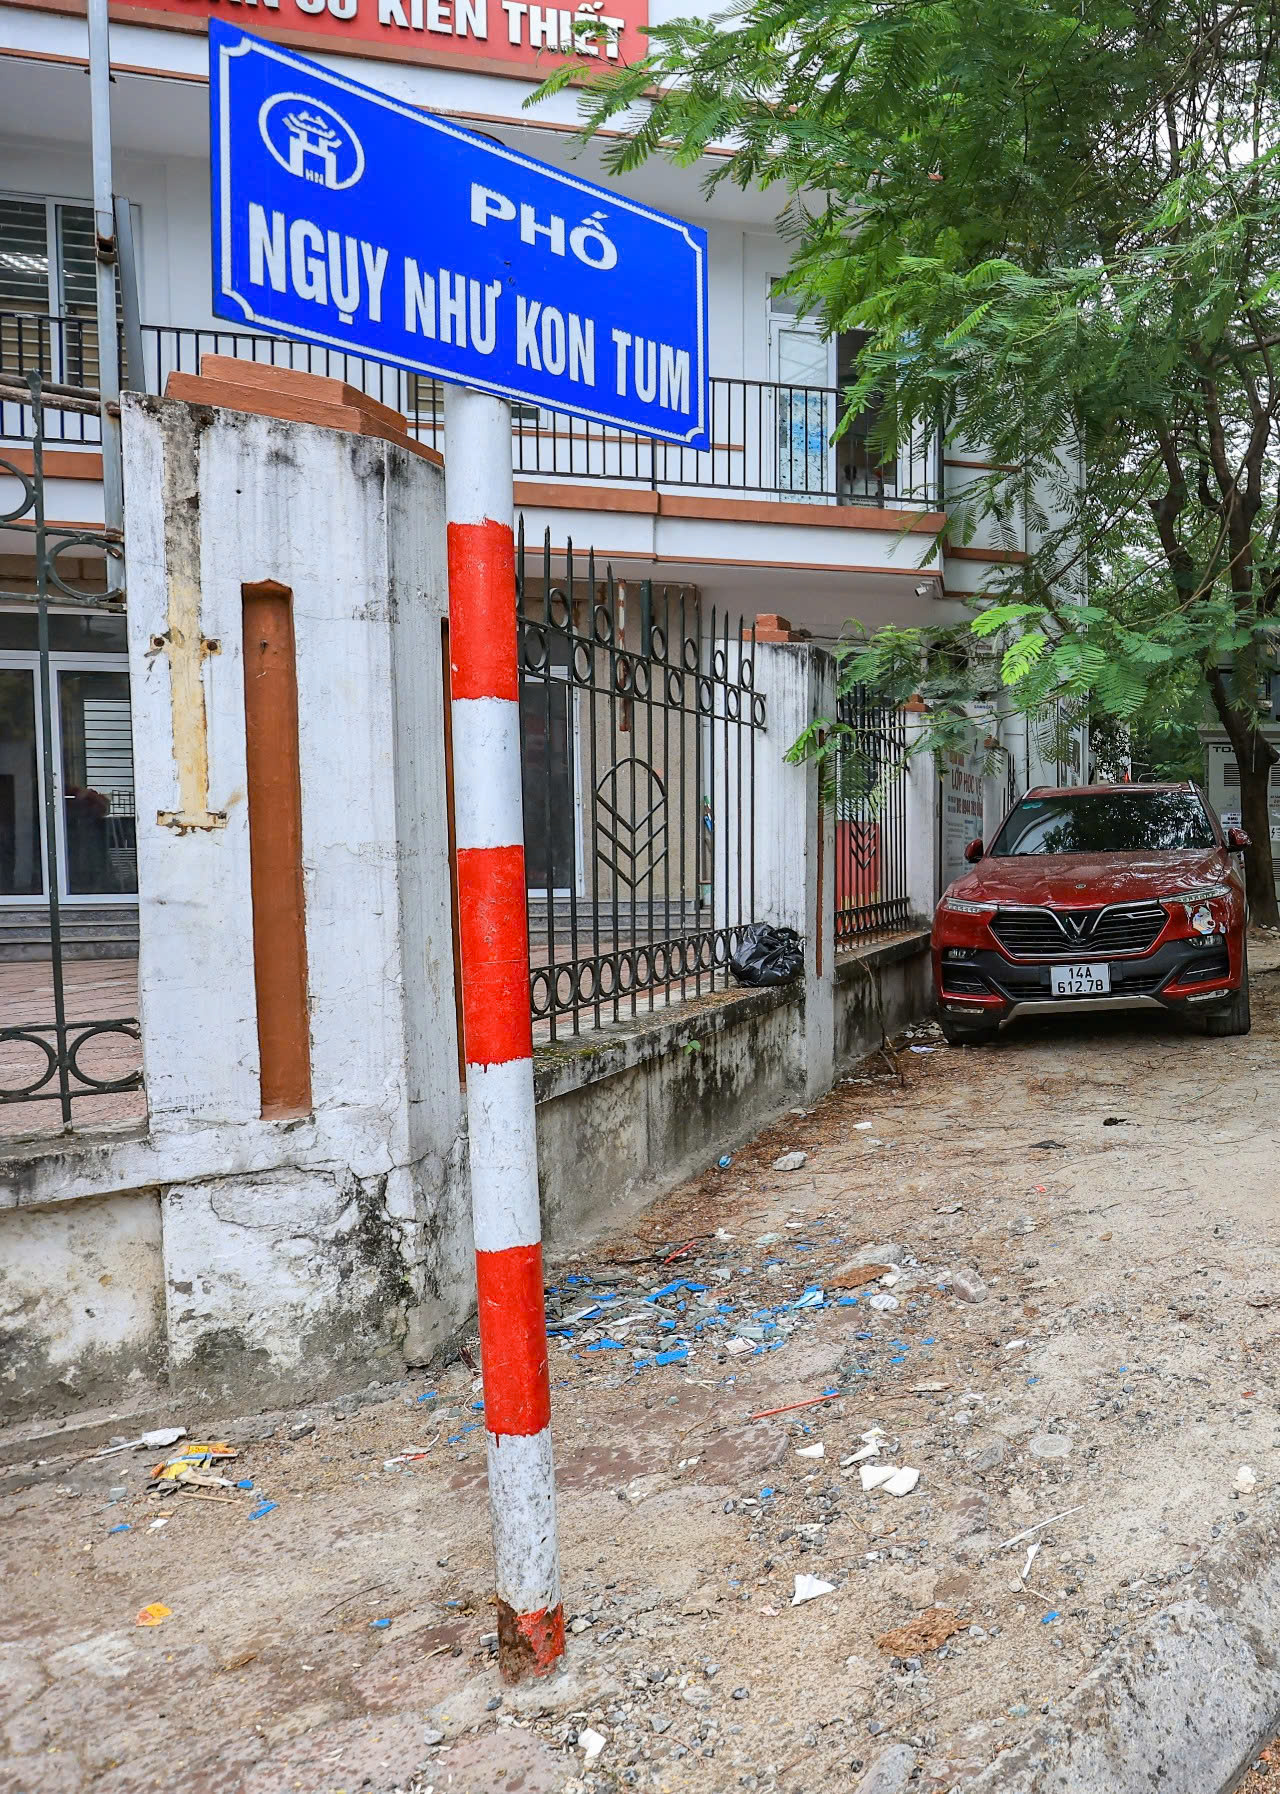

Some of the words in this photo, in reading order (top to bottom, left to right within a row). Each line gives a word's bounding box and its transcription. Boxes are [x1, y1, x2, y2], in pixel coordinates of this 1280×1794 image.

[501, 1, 626, 60] THIẾT
[470, 181, 618, 271] PHỐ
[248, 201, 389, 325] NGỤY
[404, 256, 502, 355] NHƯ
[516, 294, 596, 388] KON
[611, 327, 690, 415] TUM
[1058, 979, 1103, 993] 612.78
[1069, 967, 1092, 979] 14A
